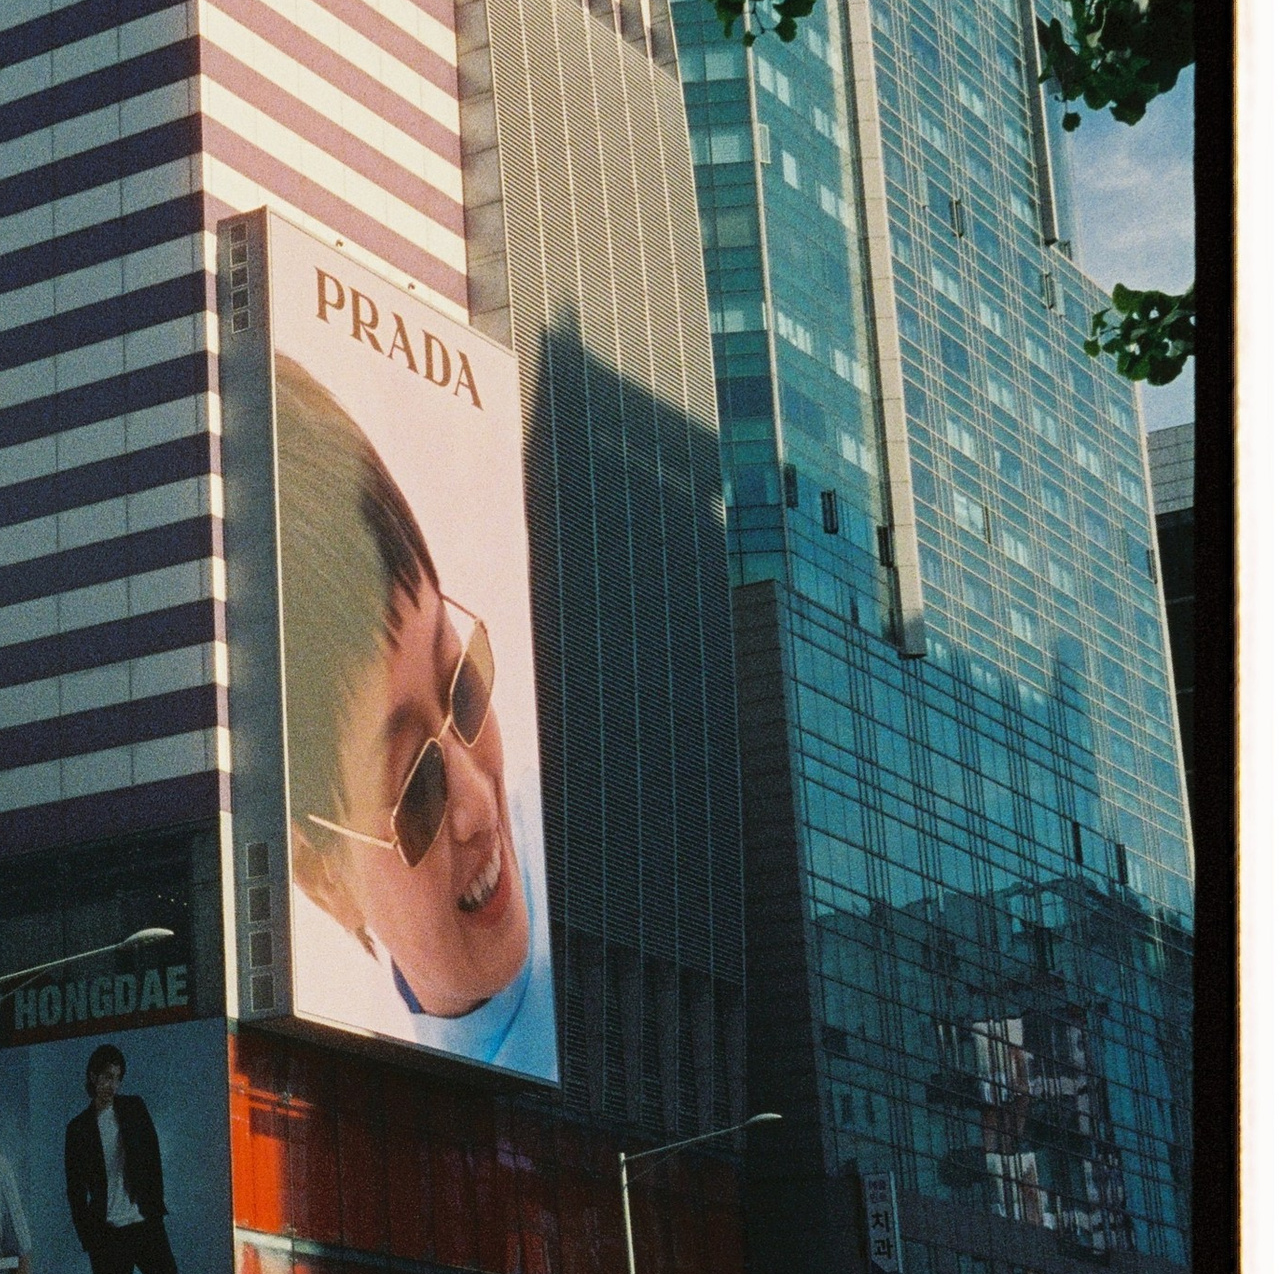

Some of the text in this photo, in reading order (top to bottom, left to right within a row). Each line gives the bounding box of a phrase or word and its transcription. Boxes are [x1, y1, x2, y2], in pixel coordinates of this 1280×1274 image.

[315, 267, 484, 411] PRADA
[12, 965, 190, 1031] HONGDAE
[871, 1211, 894, 1259] 치과
